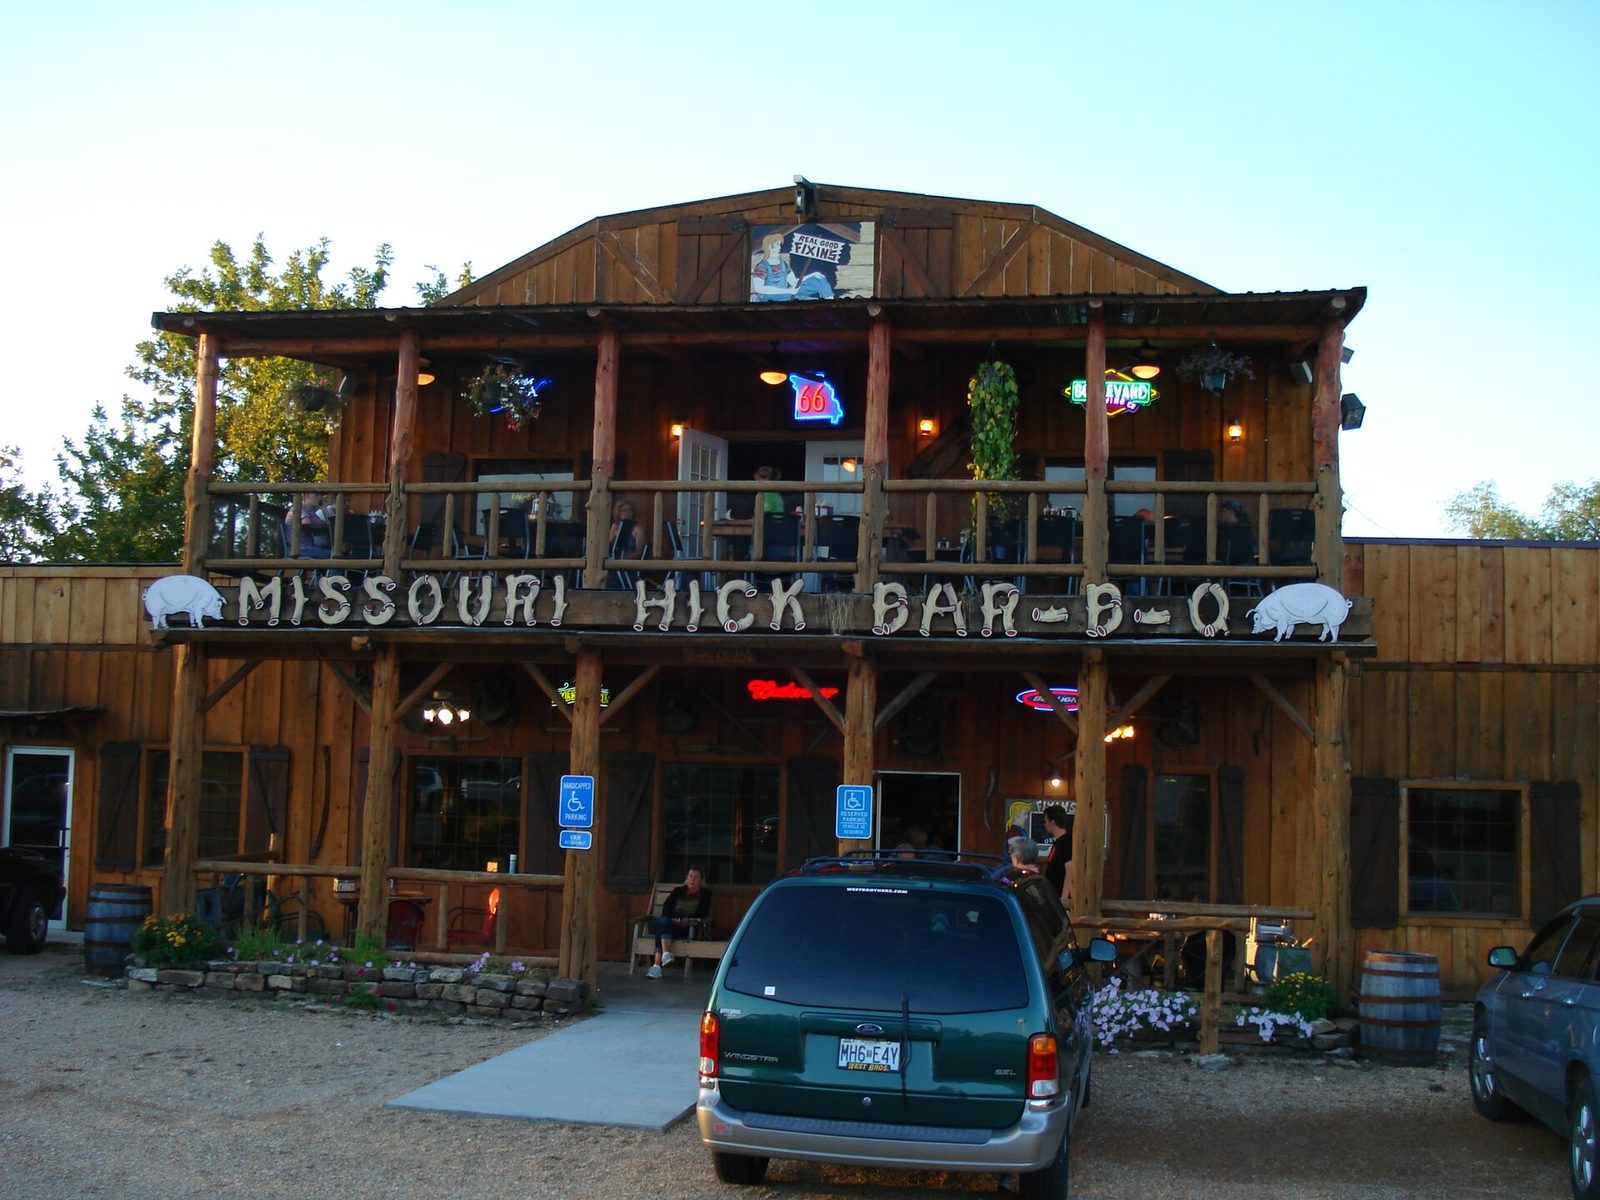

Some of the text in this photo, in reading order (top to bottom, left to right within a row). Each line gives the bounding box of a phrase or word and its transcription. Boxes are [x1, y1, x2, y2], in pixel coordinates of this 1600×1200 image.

[798, 236, 839, 250] REAL GOOD
[799, 384, 826, 413] 66
[237, 574, 569, 627] MISSOURI
[634, 577, 805, 633] HICK
[564, 813, 587, 822] PARKING
[840, 1043, 899, 1065] MH6 E4Y
[847, 1062, 867, 1070] WEST
